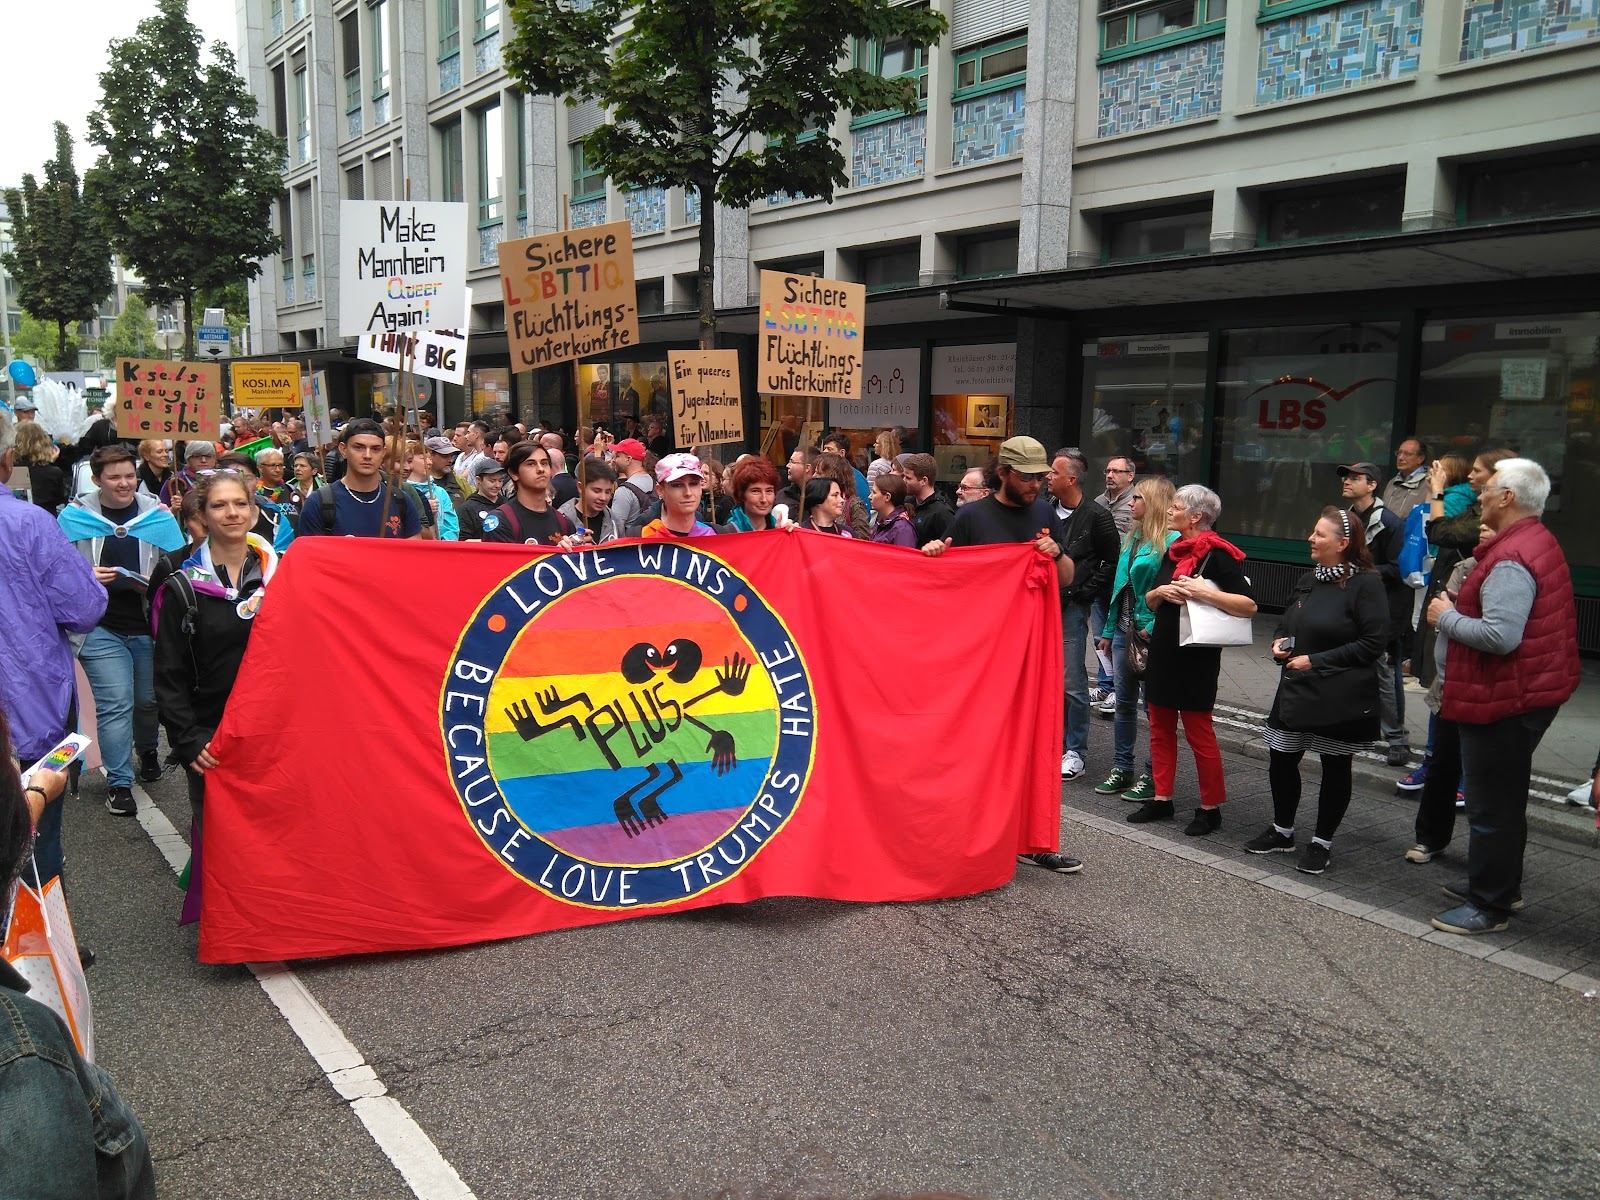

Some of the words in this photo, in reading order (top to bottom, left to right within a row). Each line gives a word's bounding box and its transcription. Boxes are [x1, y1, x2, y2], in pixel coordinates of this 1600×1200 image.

[380, 206, 436, 244] Make
[358, 246, 444, 280] Mannheim
[525, 234, 616, 272] Sichere
[388, 276, 442, 300] Queer
[505, 260, 624, 306] LSBTTIQ
[784, 276, 847, 308] Sichere
[366, 300, 430, 332] Again!
[514, 299, 634, 340] Flüchtlings-
[764, 303, 858, 340] LSBTTIQ
[425, 344, 456, 372] BIG
[521, 328, 630, 366] unterkünfte
[766, 335, 862, 377] Flüchtlings-
[242, 379, 290, 388] KOSI.MA
[674, 360, 692, 380] Ein
[698, 368, 730, 383] queeres
[768, 366, 851, 395] unterkünfte
[678, 389, 738, 419] Jugendzentrum
[840, 403, 911, 414] fotoinitiative
[1259, 399, 1327, 430] LBS
[680, 424, 696, 445] für
[698, 419, 740, 442] Mannheim
[506, 549, 614, 614] LOVE
[638, 544, 731, 596] WINS
[584, 682, 683, 770] PLUS
[445, 659, 532, 862] BECAUSE
[540, 854, 640, 904] LOVE
[670, 770, 800, 892] TRUMPS
[759, 640, 811, 736] HATE
